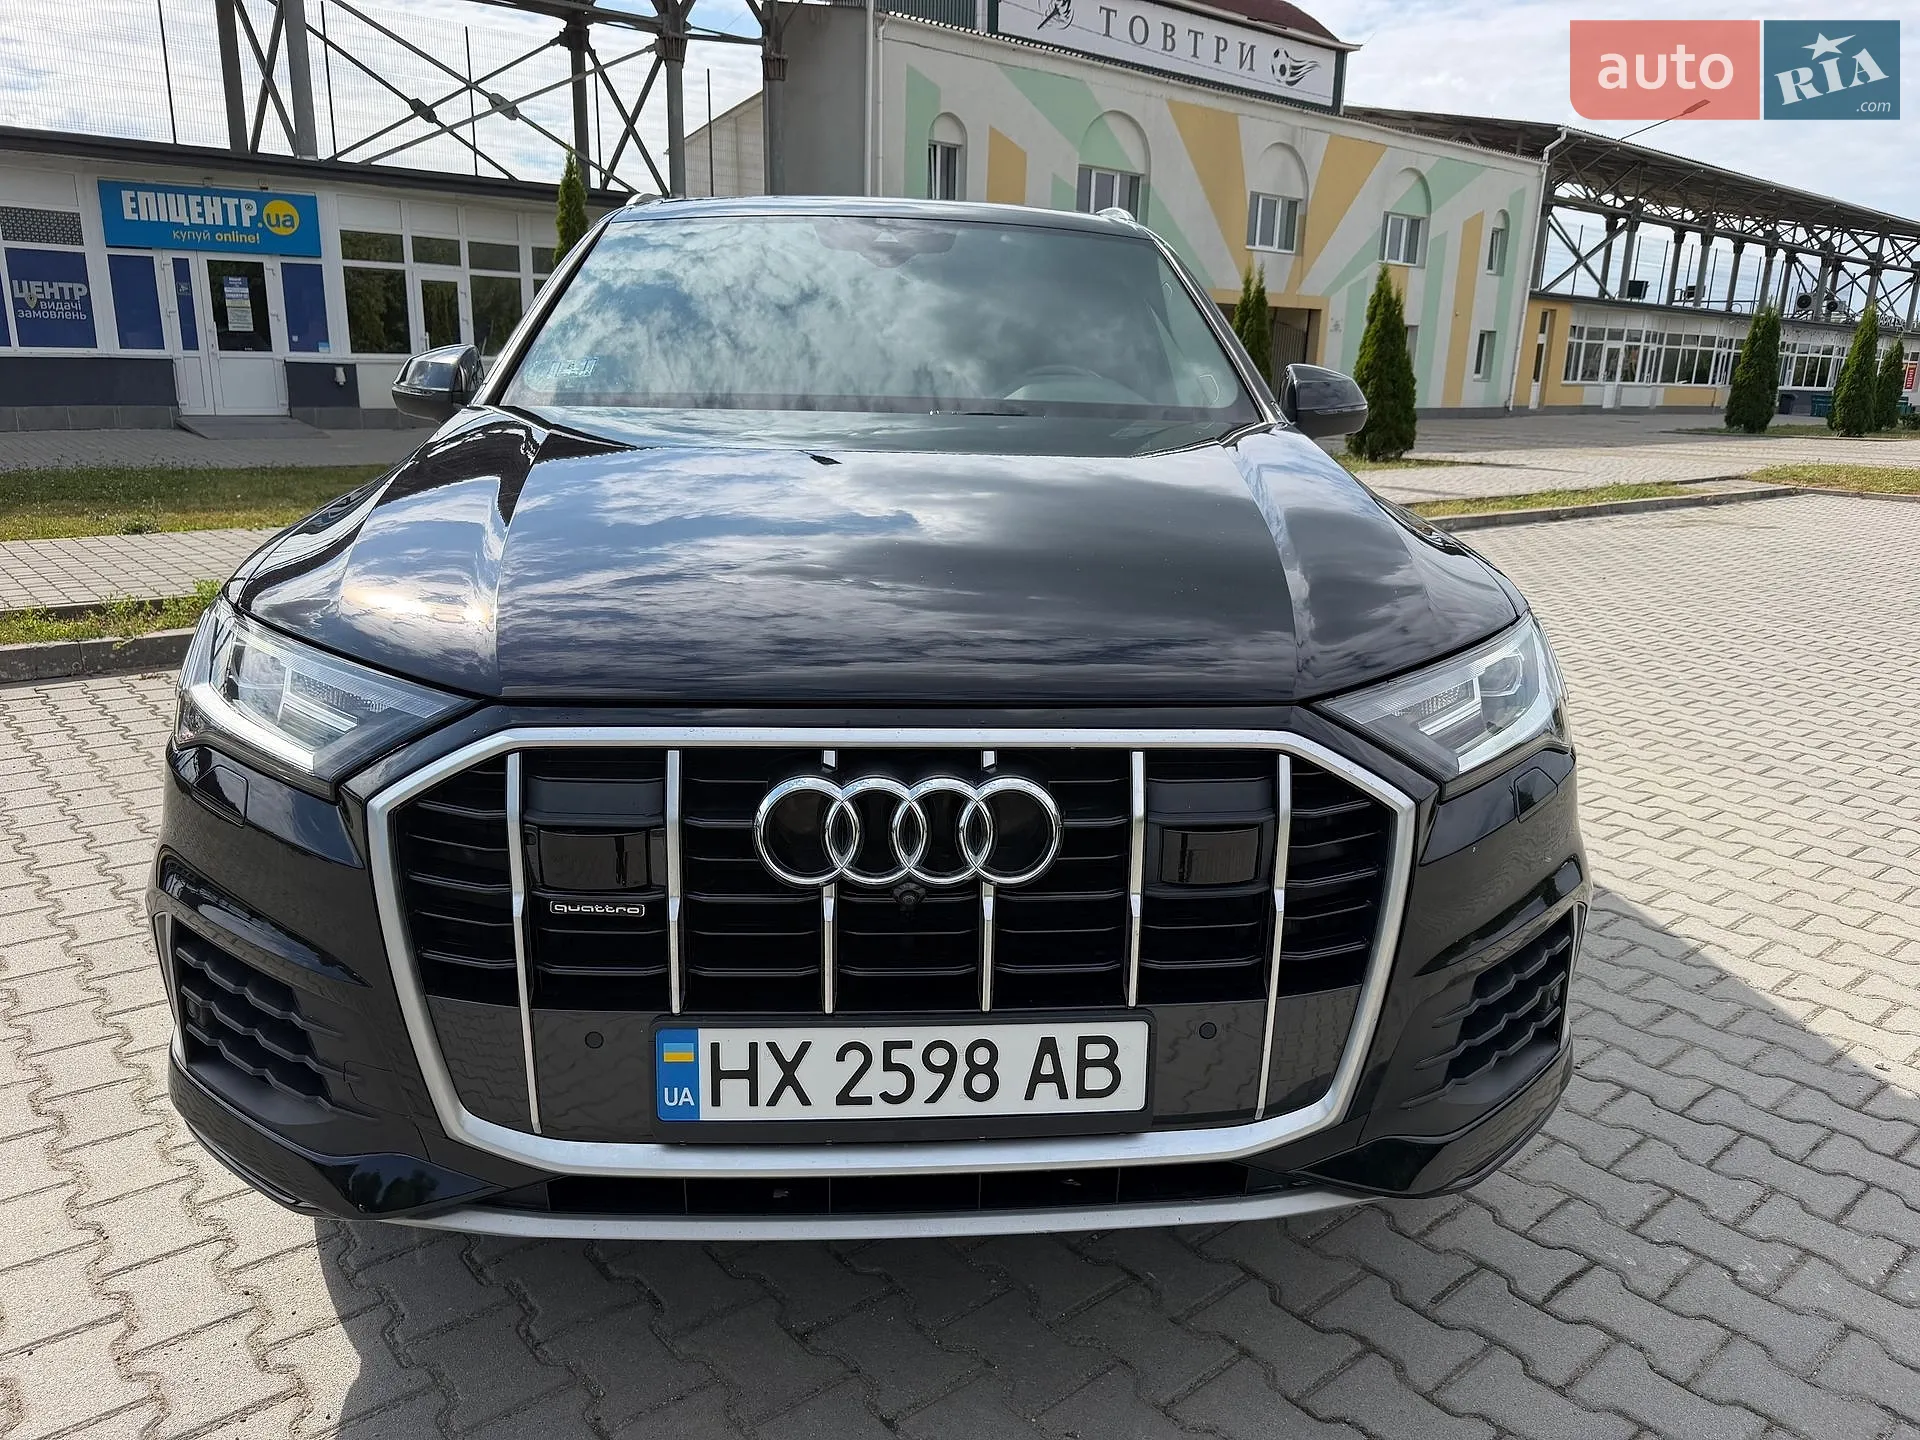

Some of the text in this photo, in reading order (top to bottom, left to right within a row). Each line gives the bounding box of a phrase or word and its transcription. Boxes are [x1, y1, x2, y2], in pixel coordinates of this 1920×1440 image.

[1099, 5, 1256, 73] ТОВТРИ
[173, 229, 260, 244] купуй online!
[12, 280, 88, 300] ЦЕНТР
[40, 300, 81, 311] видачі
[17, 309, 87, 320] замовлень
[554, 903, 640, 914] quattro
[710, 1035, 1122, 1107] HX 2598 AB
[664, 1086, 695, 1107] UA
